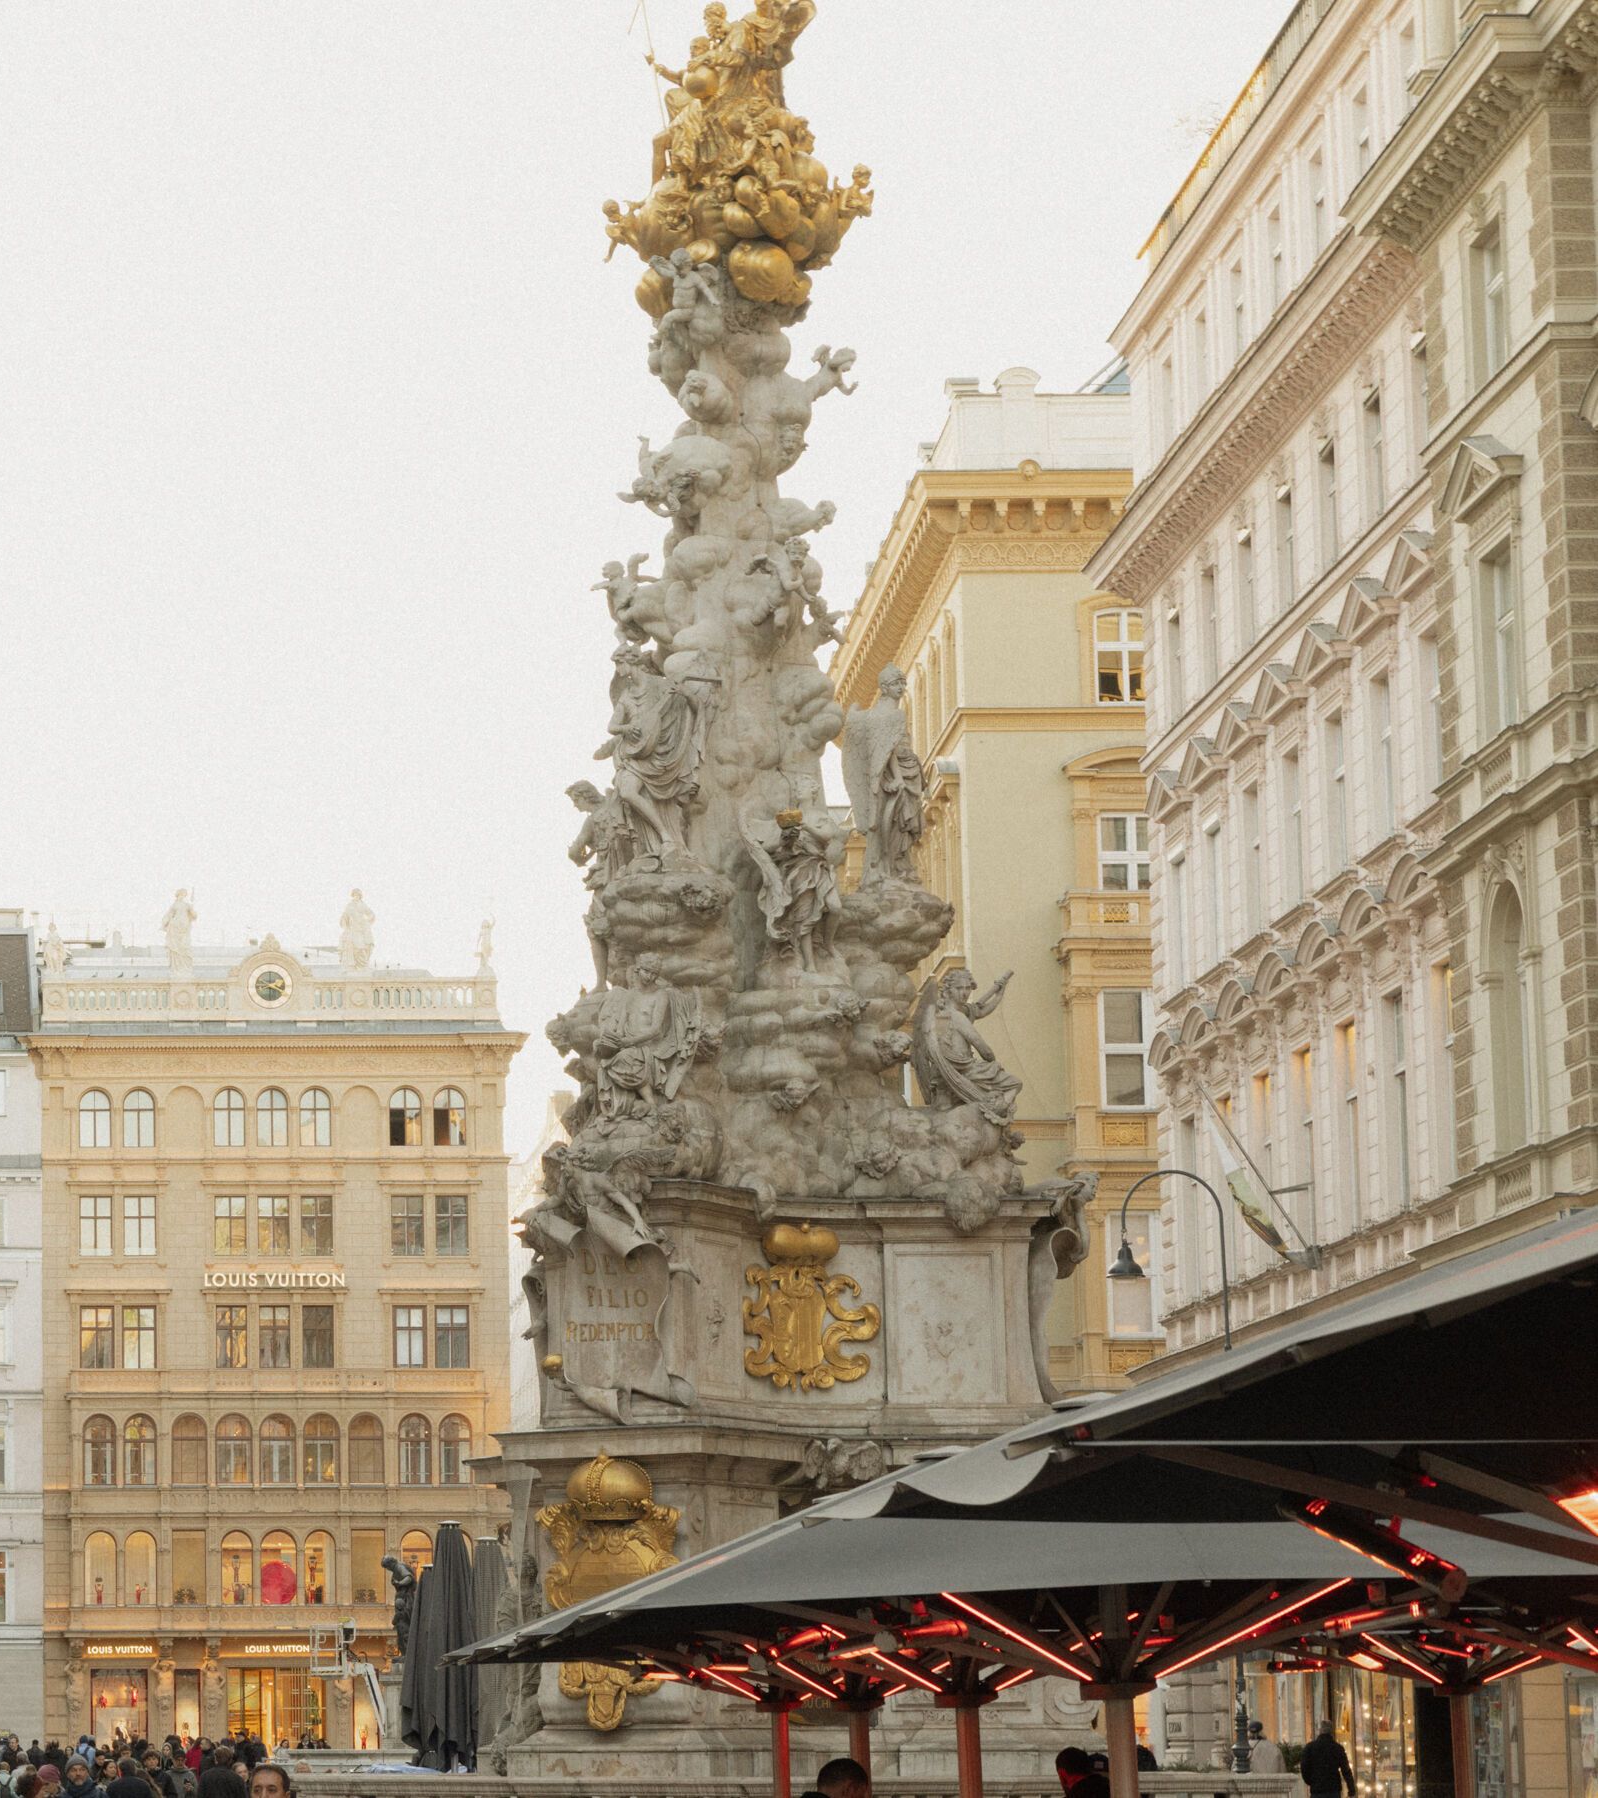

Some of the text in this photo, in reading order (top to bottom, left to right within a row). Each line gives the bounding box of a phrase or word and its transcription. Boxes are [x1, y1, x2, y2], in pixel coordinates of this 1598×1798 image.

[204, 1272, 346, 1287] LOUIS VUITTON
[587, 1286, 649, 1308] FILIO
[87, 1645, 153, 1655] LOUIS VUITTON
[245, 1645, 310, 1653] LOUIS VUITTON
